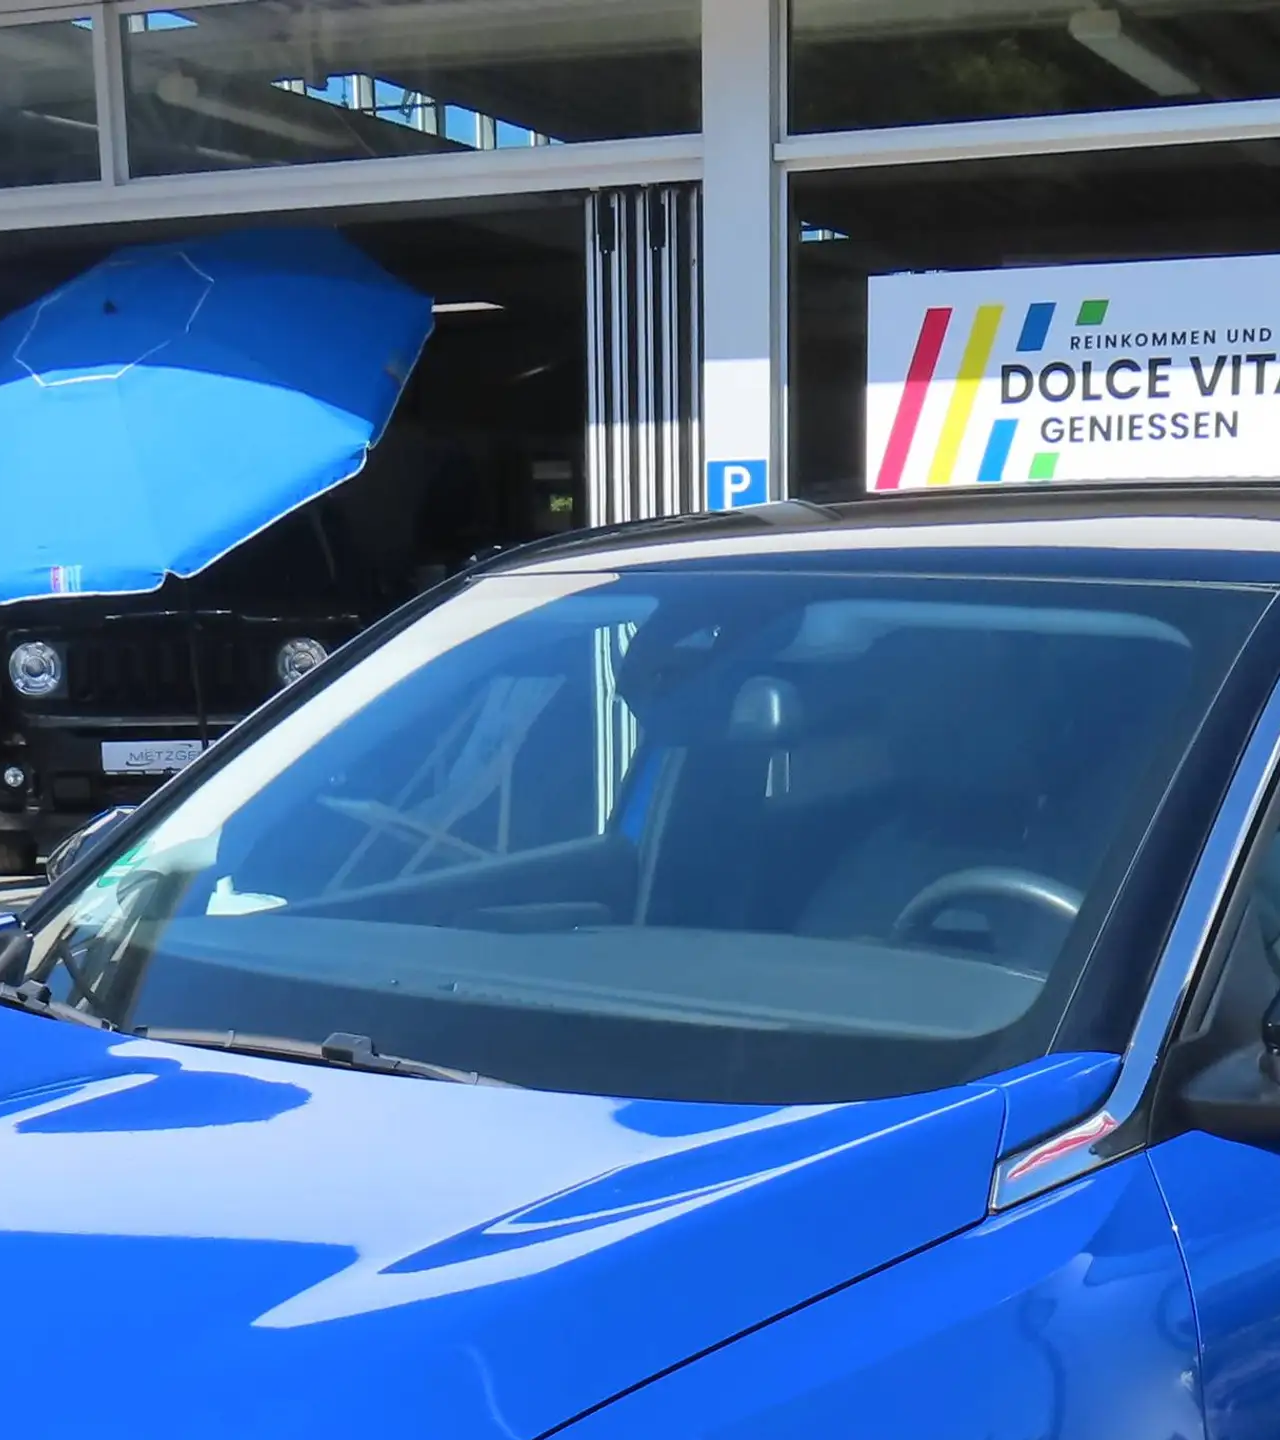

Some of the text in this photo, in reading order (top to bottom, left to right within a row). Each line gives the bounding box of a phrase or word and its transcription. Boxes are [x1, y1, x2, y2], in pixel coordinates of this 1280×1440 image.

[1070, 327, 1272, 350] REINKOMMEN UND
[1001, 357, 1171, 405] DOLCE
[1041, 411, 1238, 444] GENIESSEN
[723, 465, 751, 509] P
